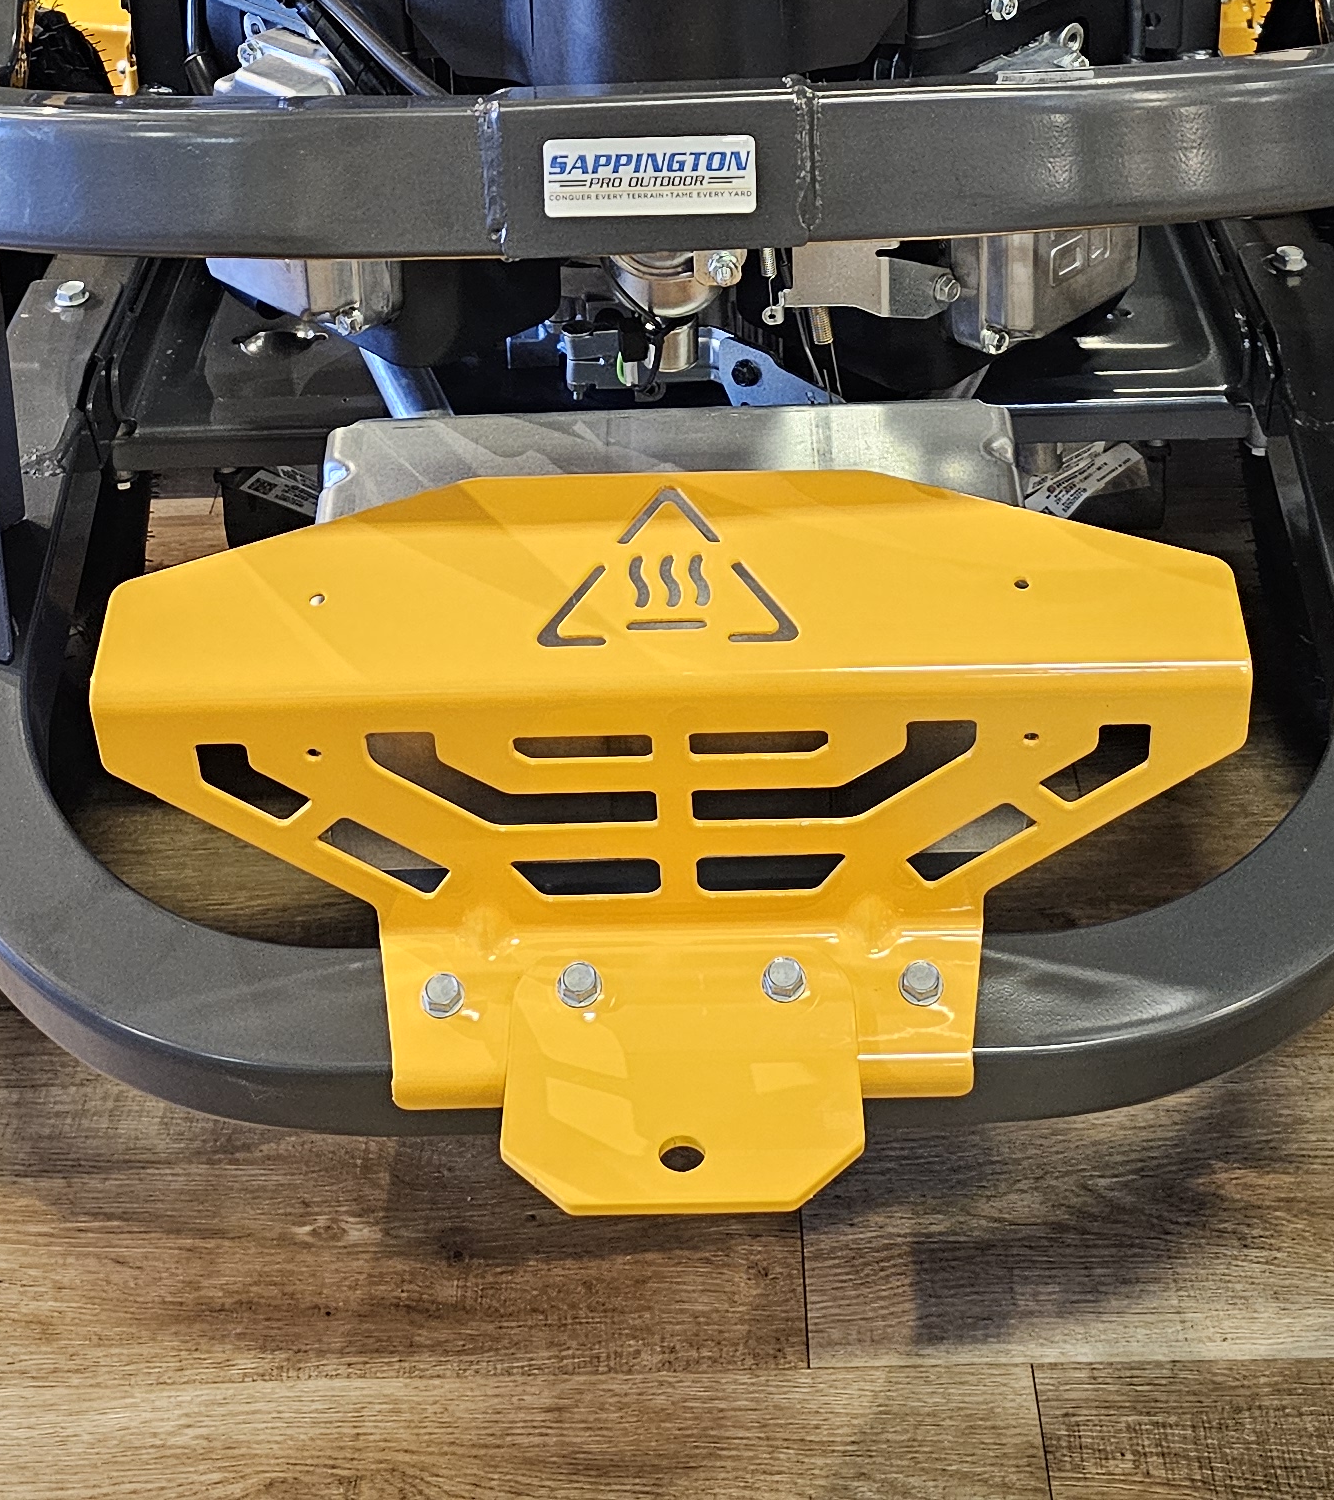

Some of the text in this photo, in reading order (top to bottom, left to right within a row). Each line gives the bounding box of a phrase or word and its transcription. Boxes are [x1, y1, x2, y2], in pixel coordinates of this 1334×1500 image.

[548, 150, 751, 176] SAPPINGTON
[588, 175, 706, 189] PRO OUTDOOR
[549, 194, 593, 202] CONQUER
[595, 193, 623, 201] EVERY
[697, 190, 726, 199] EVERY
[728, 189, 753, 198] YARD
